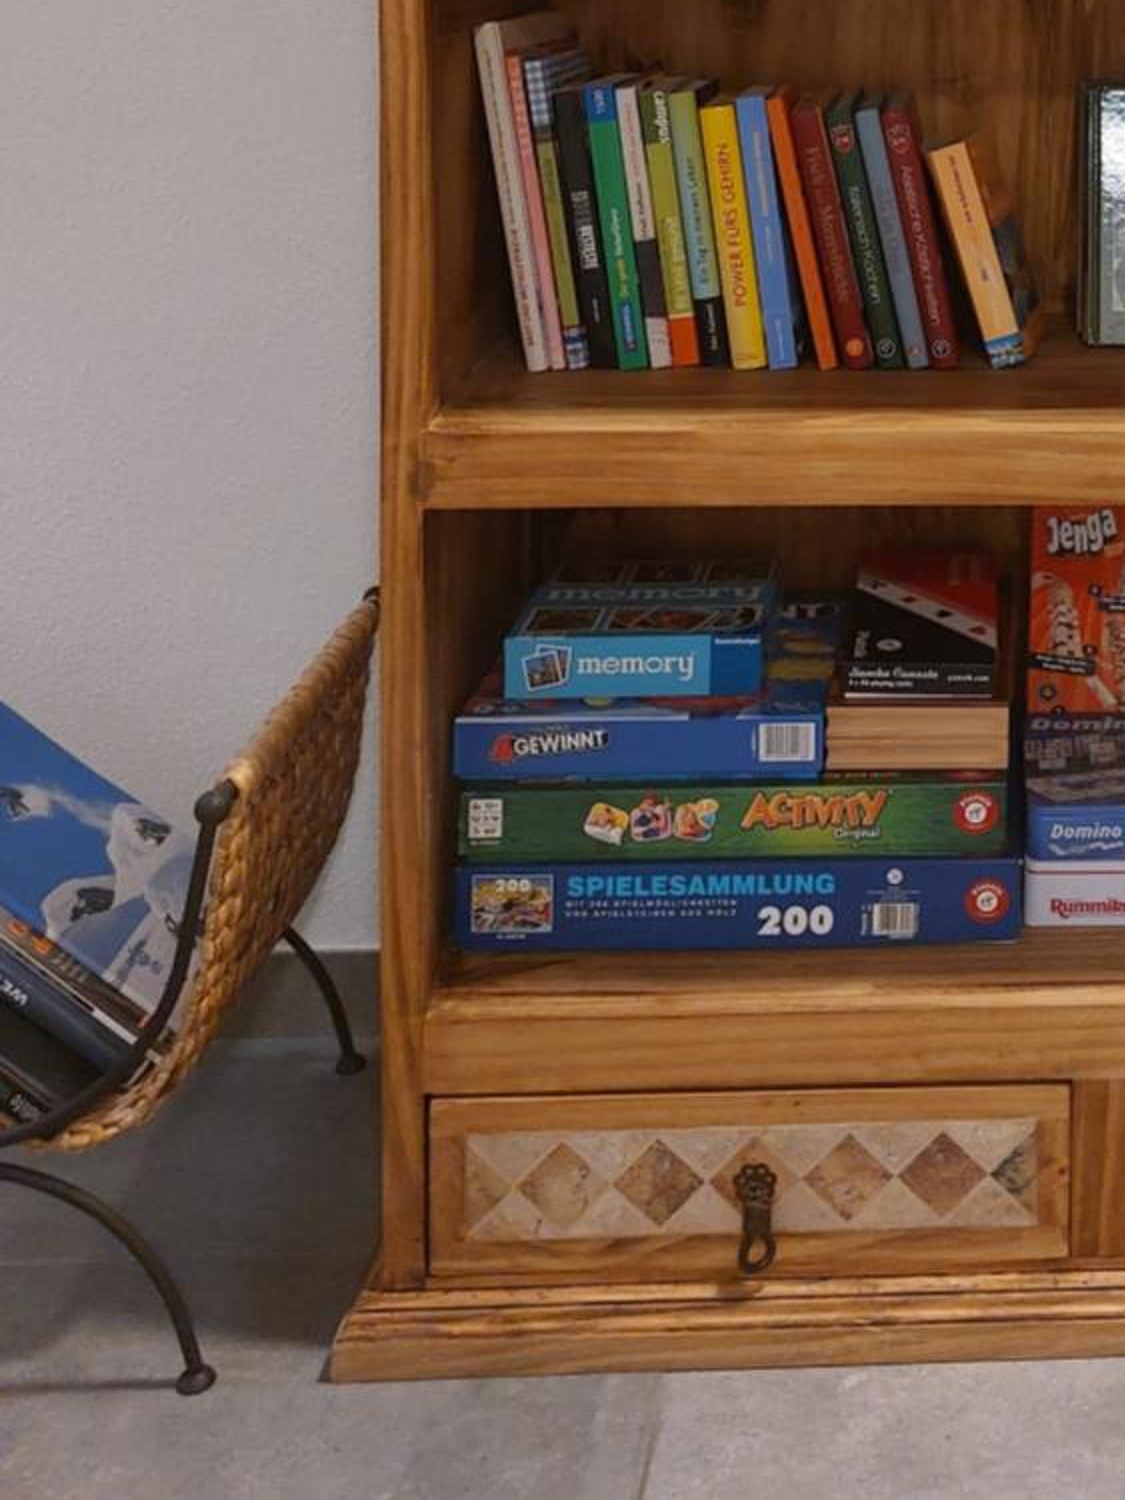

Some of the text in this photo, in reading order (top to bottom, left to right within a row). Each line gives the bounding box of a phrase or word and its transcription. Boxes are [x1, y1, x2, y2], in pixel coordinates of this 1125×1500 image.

[717, 144, 736, 201] GEHIRN
[729, 249, 749, 309] POWER
[1047, 507, 1118, 554] Jenga
[577, 651, 695, 681] memory
[514, 729, 606, 756] GEWINNT
[740, 789, 888, 831] ACTIVITY
[1050, 822, 1123, 839] Domino
[567, 873, 836, 898] SPIELESAMMLUNG
[757, 904, 834, 936] 200
